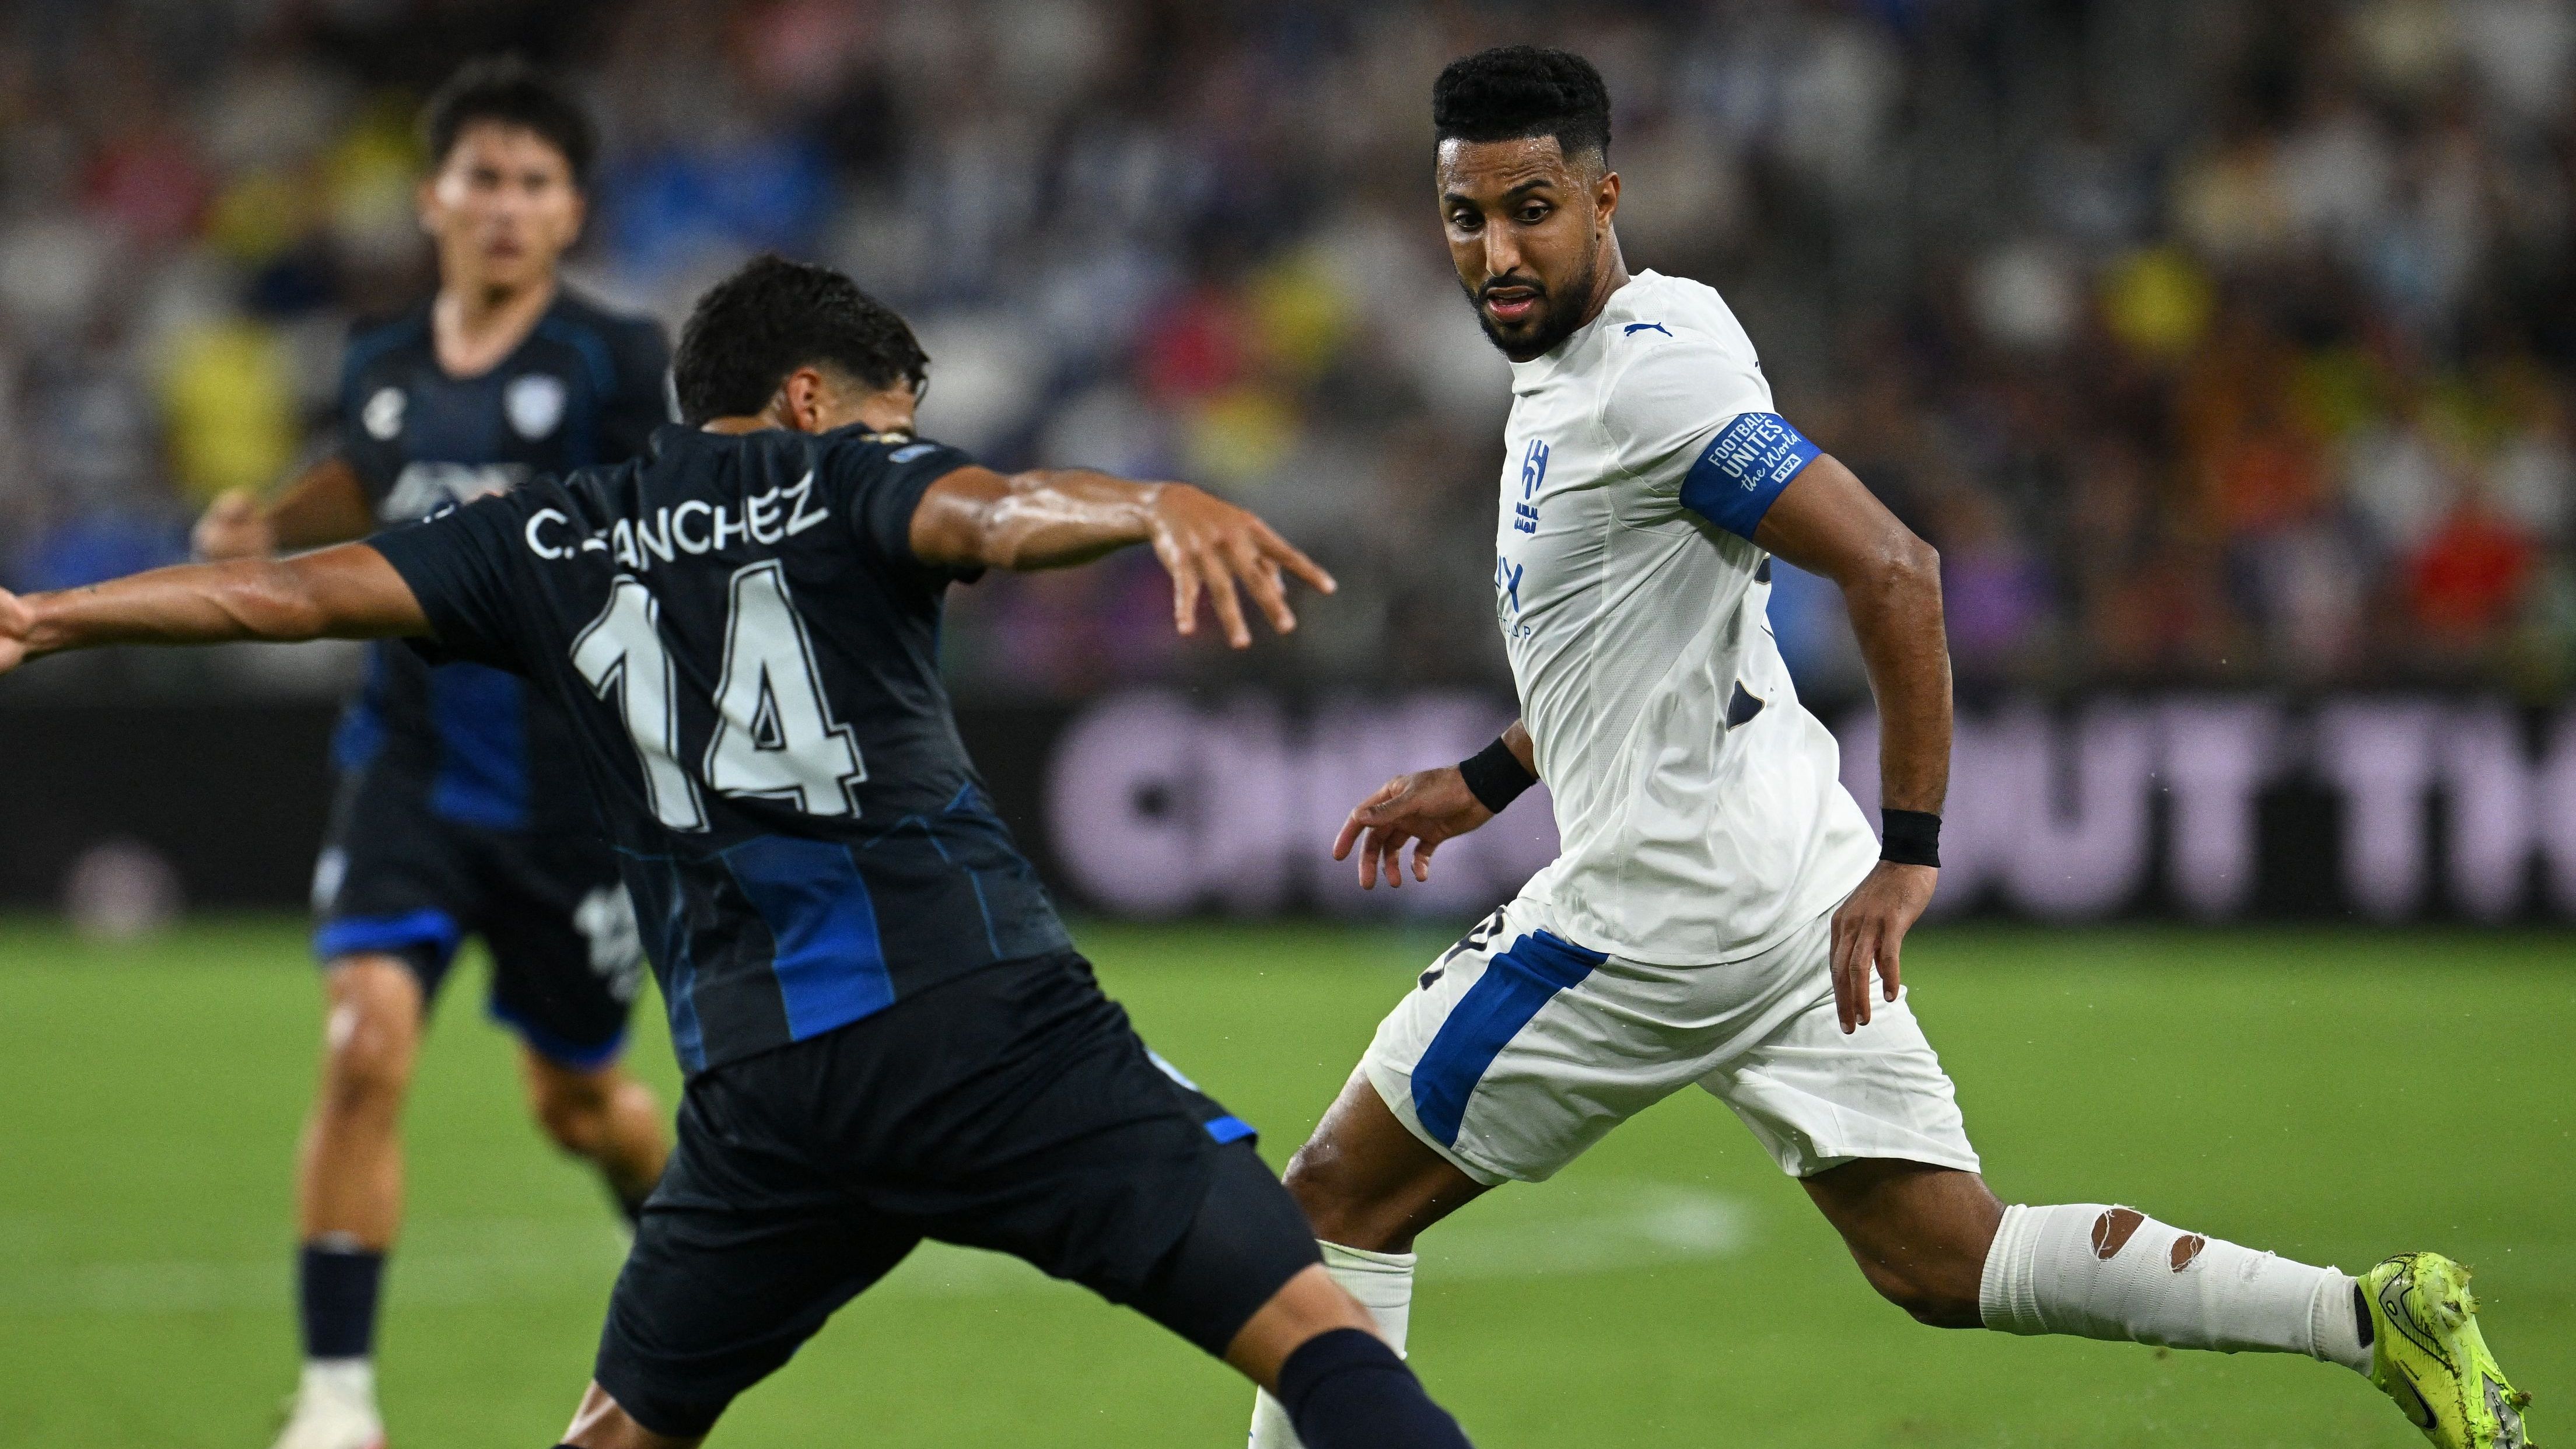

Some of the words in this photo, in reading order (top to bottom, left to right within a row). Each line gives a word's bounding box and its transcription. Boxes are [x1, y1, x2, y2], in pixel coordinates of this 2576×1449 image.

[1721, 418, 1783, 478] UNITES
[1740, 467, 1766, 492] the
[1759, 429, 1803, 468] World
[1774, 457, 1798, 479] FIFA
[570, 559, 869, 832] 14
